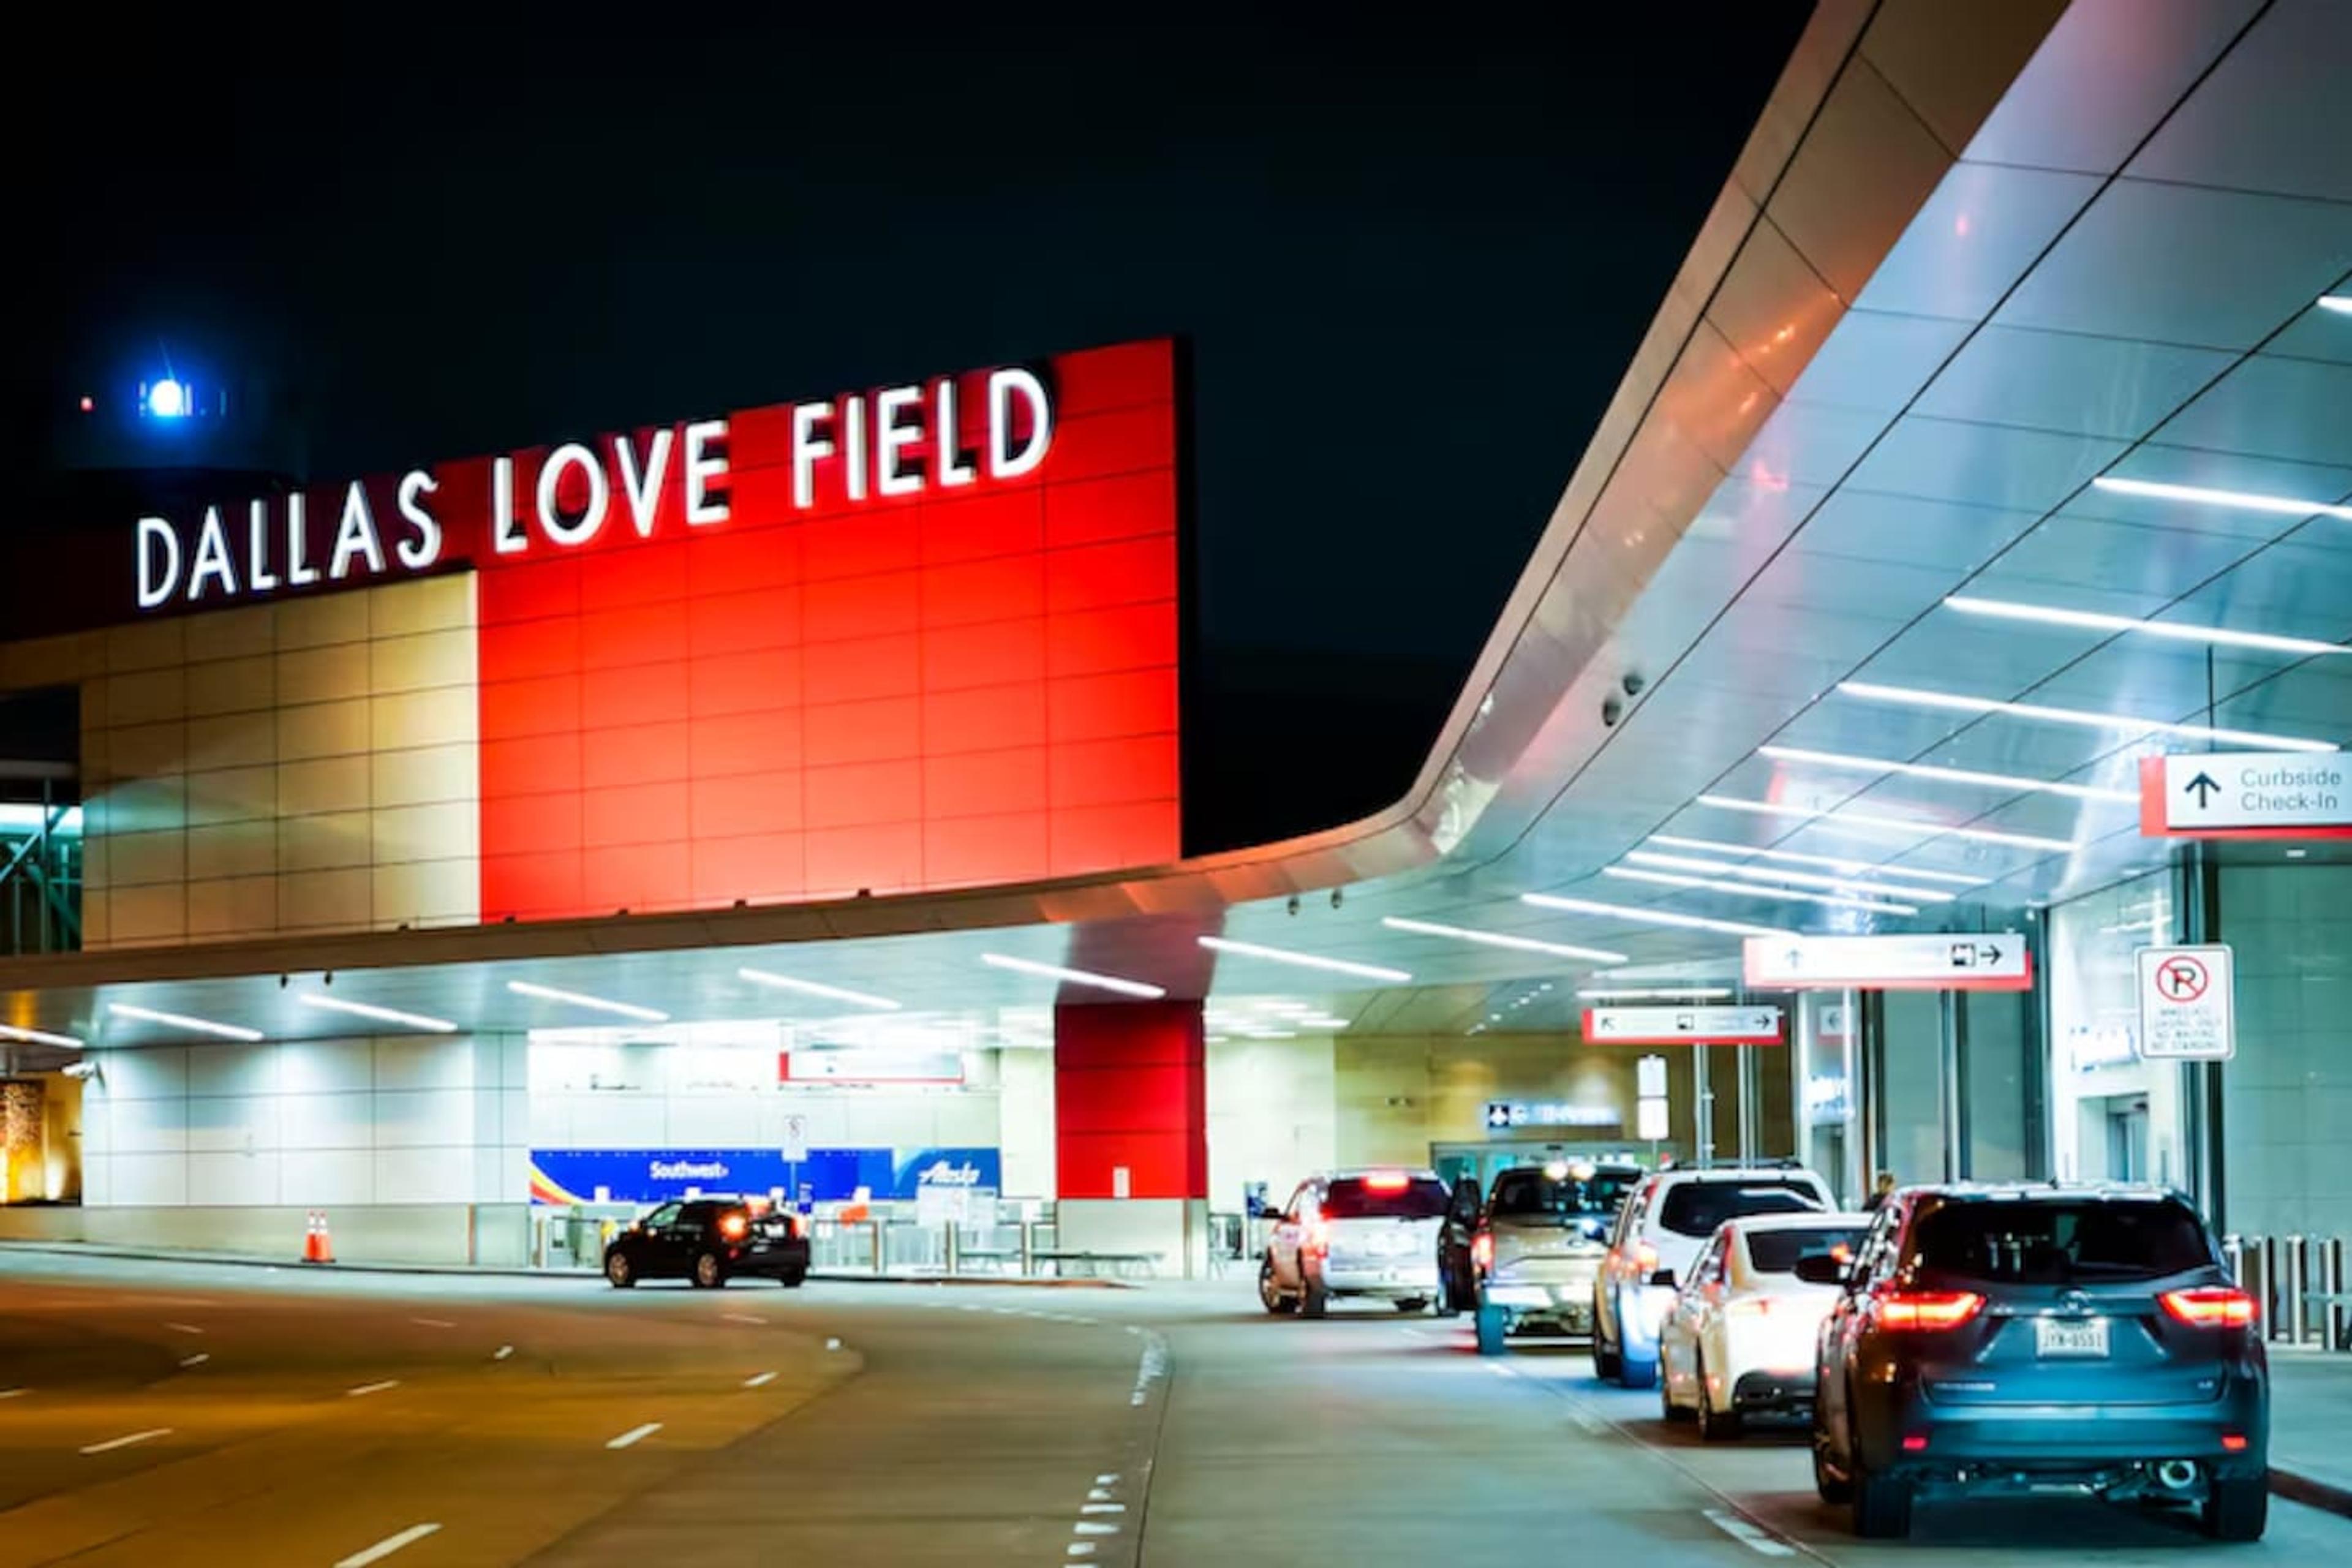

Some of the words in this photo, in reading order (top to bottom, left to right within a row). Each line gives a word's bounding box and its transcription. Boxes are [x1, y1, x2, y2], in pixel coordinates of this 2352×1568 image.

[137, 470, 443, 608] DALLAS
[494, 420, 729, 553] LOVE
[792, 368, 1052, 508] FIELD
[2241, 767, 2341, 787] Curbside
[2241, 791, 2339, 812] Check-In
[649, 1161, 722, 1180] Southwest
